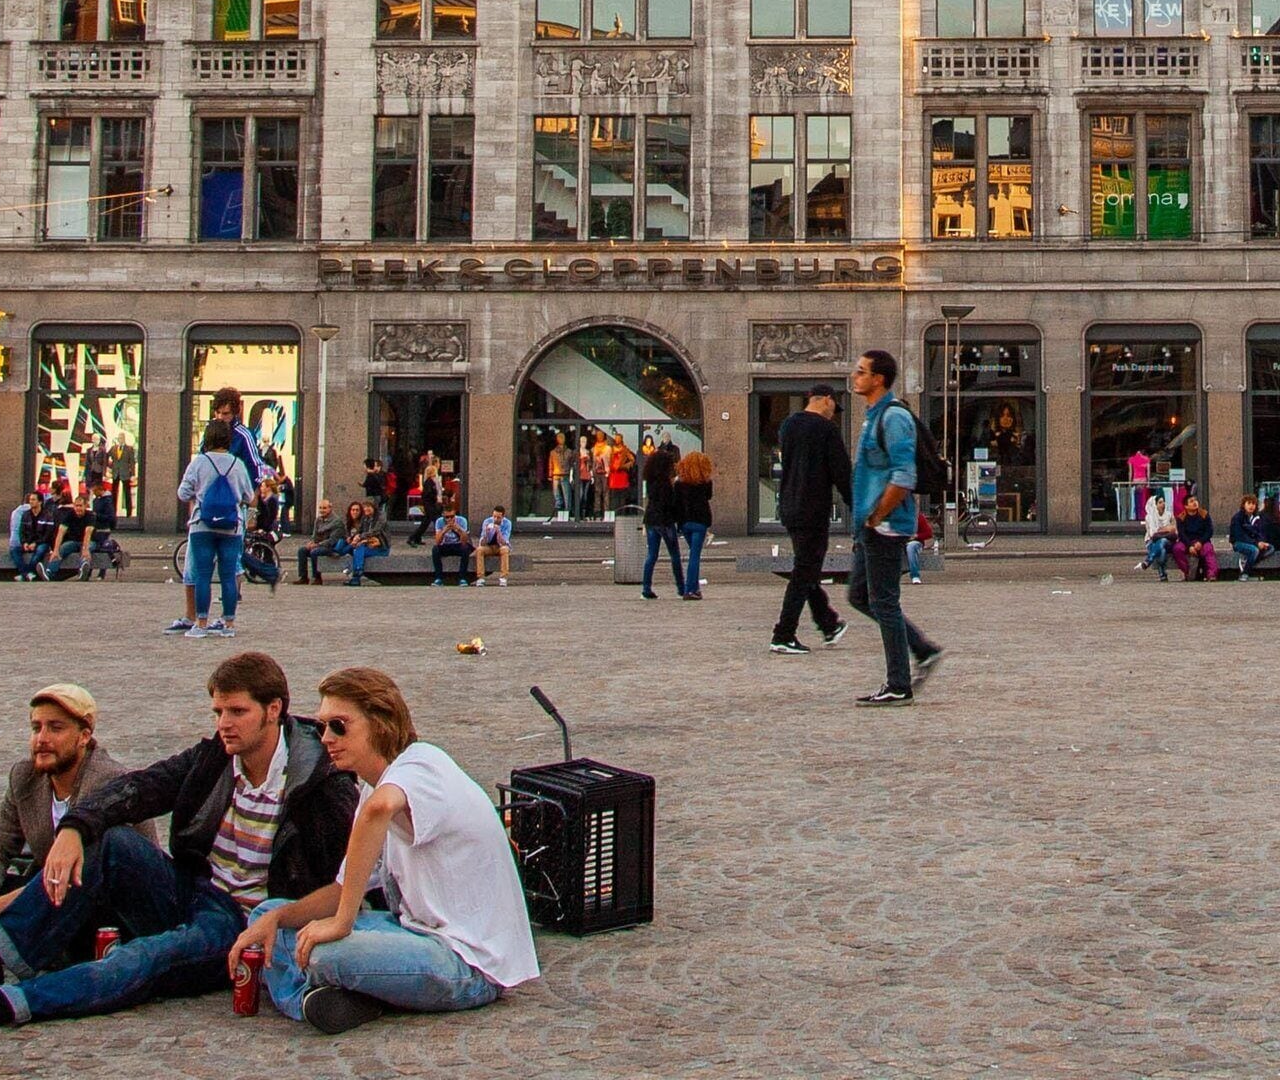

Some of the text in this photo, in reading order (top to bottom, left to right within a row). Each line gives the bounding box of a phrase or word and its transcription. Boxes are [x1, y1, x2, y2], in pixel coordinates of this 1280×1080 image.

[319, 256, 902, 283] PEEK & CLOPPENBURG
